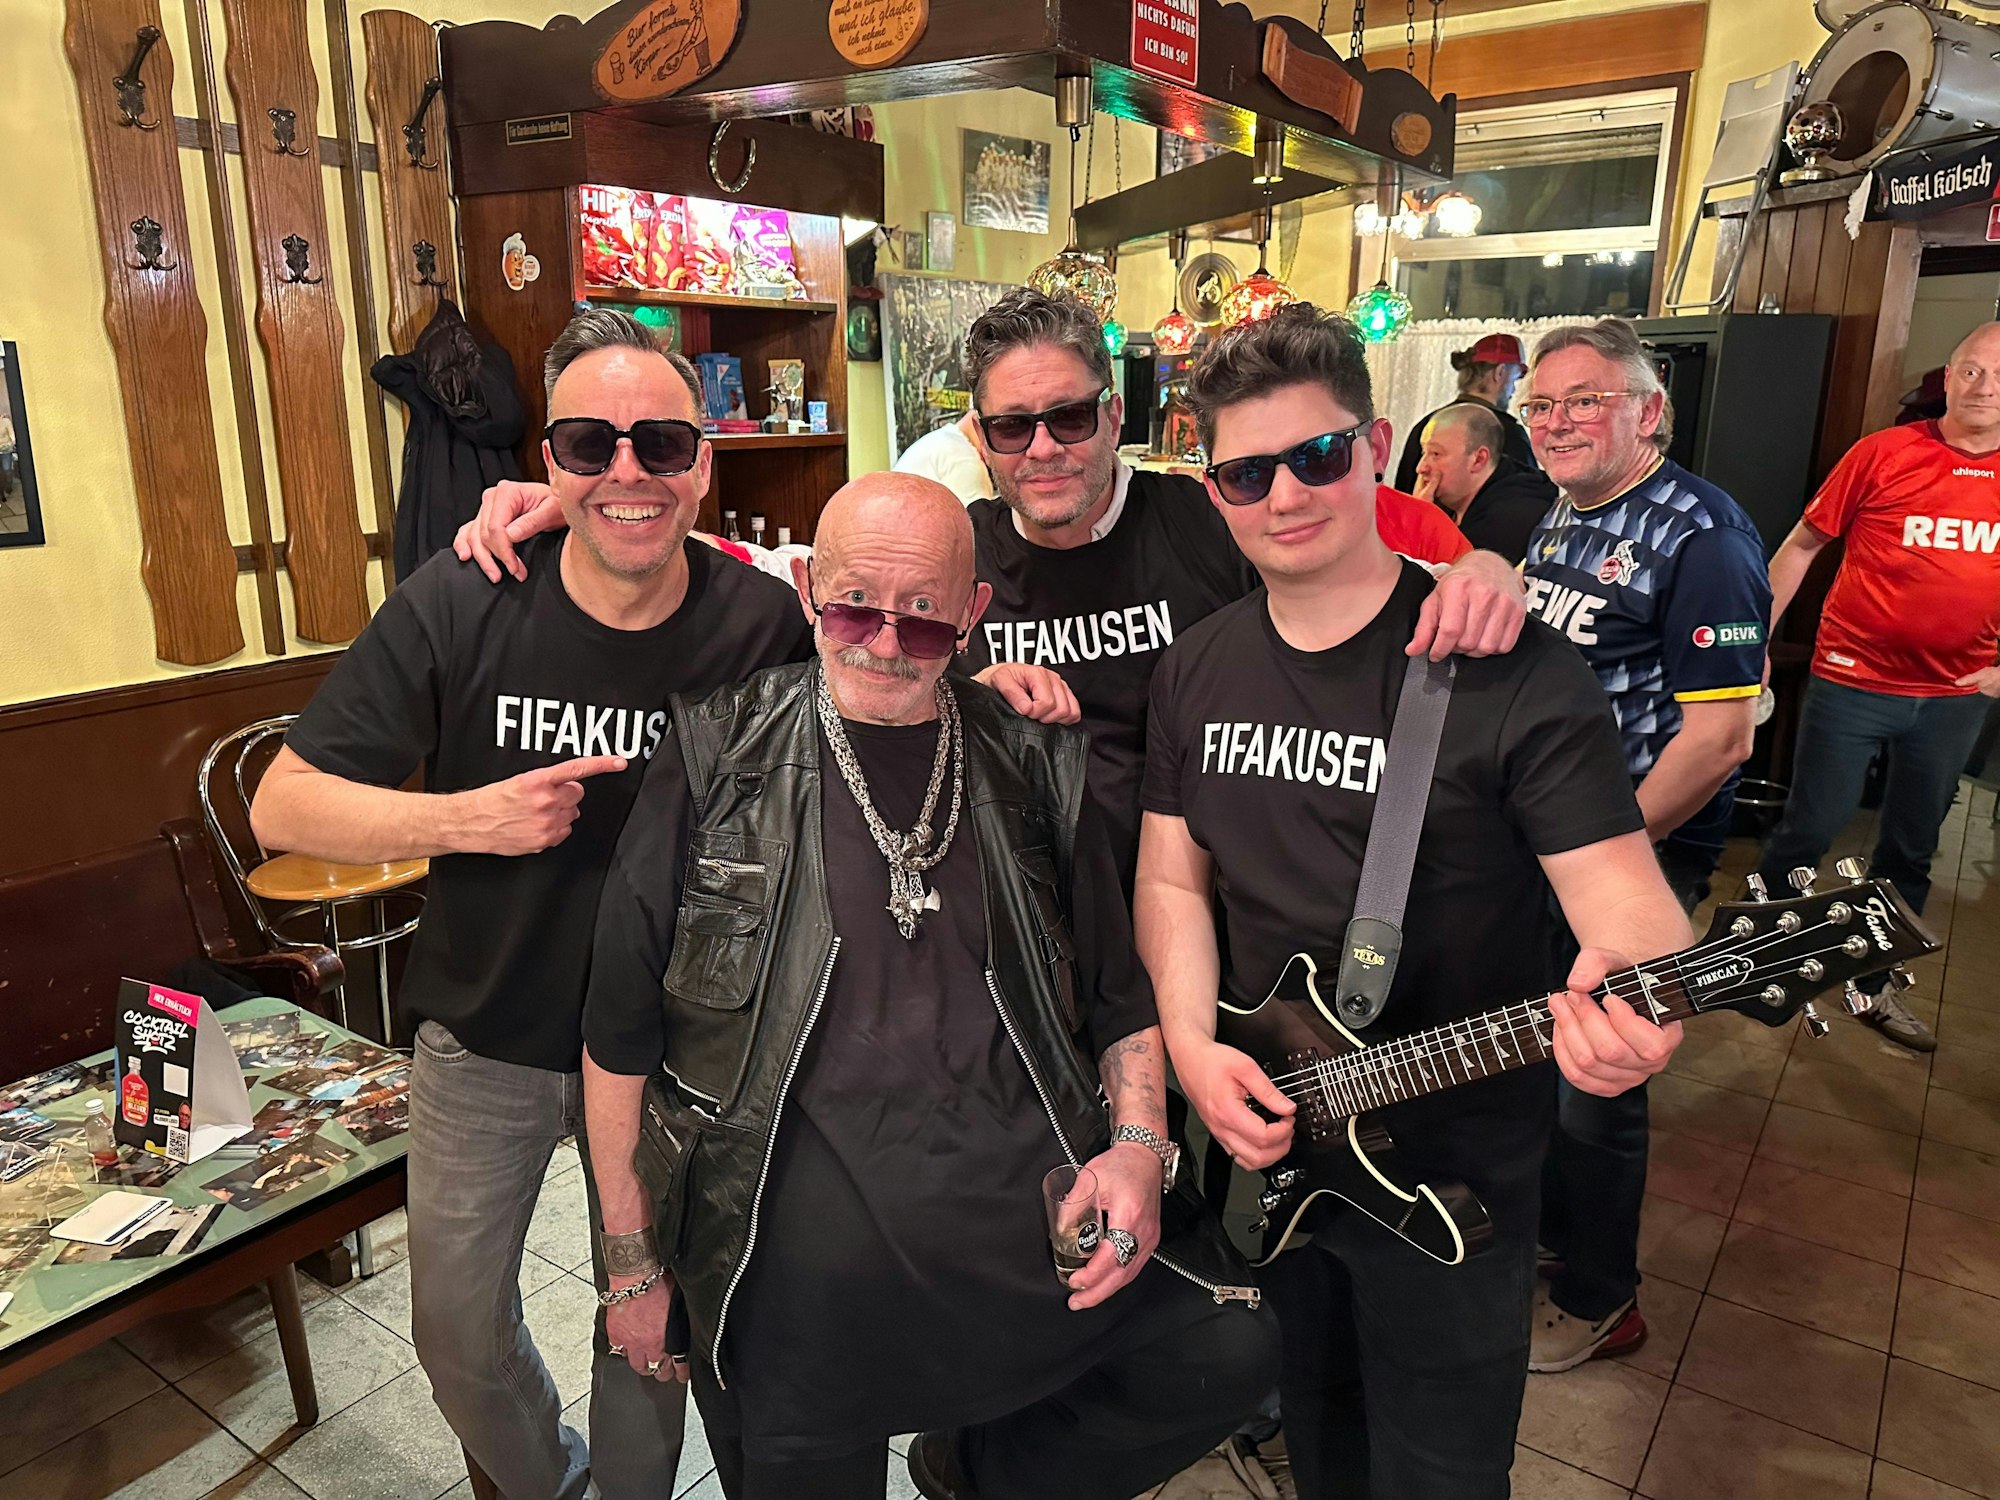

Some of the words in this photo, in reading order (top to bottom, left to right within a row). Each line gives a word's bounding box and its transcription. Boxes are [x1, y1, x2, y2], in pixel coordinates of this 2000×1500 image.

[838, 14, 858, 33] und
[861, 7, 876, 27] ich
[1137, 2, 1168, 27] NICHTS
[627, 21, 647, 48] Bier
[847, 30, 859, 46] ich
[856, 41, 872, 56] noch
[1145, 37, 1159, 54] ICH
[1160, 43, 1174, 60] BIN
[1176, 49, 1188, 65] SO!
[1890, 172, 1932, 206] Gaffel
[1933, 154, 1993, 199] Kölsch
[1952, 467, 1995, 479] uhlsport
[1902, 515, 2000, 553] REW
[1523, 575, 1608, 645] EWE
[984, 600, 1174, 666] FIFAKUSEN
[1720, 626, 1757, 642] DEVK
[496, 695, 672, 760] FIFAKUS
[1852, 897, 1896, 952] Fame
[1353, 948, 1385, 966] TEXAS
[1696, 964, 1741, 988] FIRECAT
[123, 1009, 189, 1039] COCKTAIL
